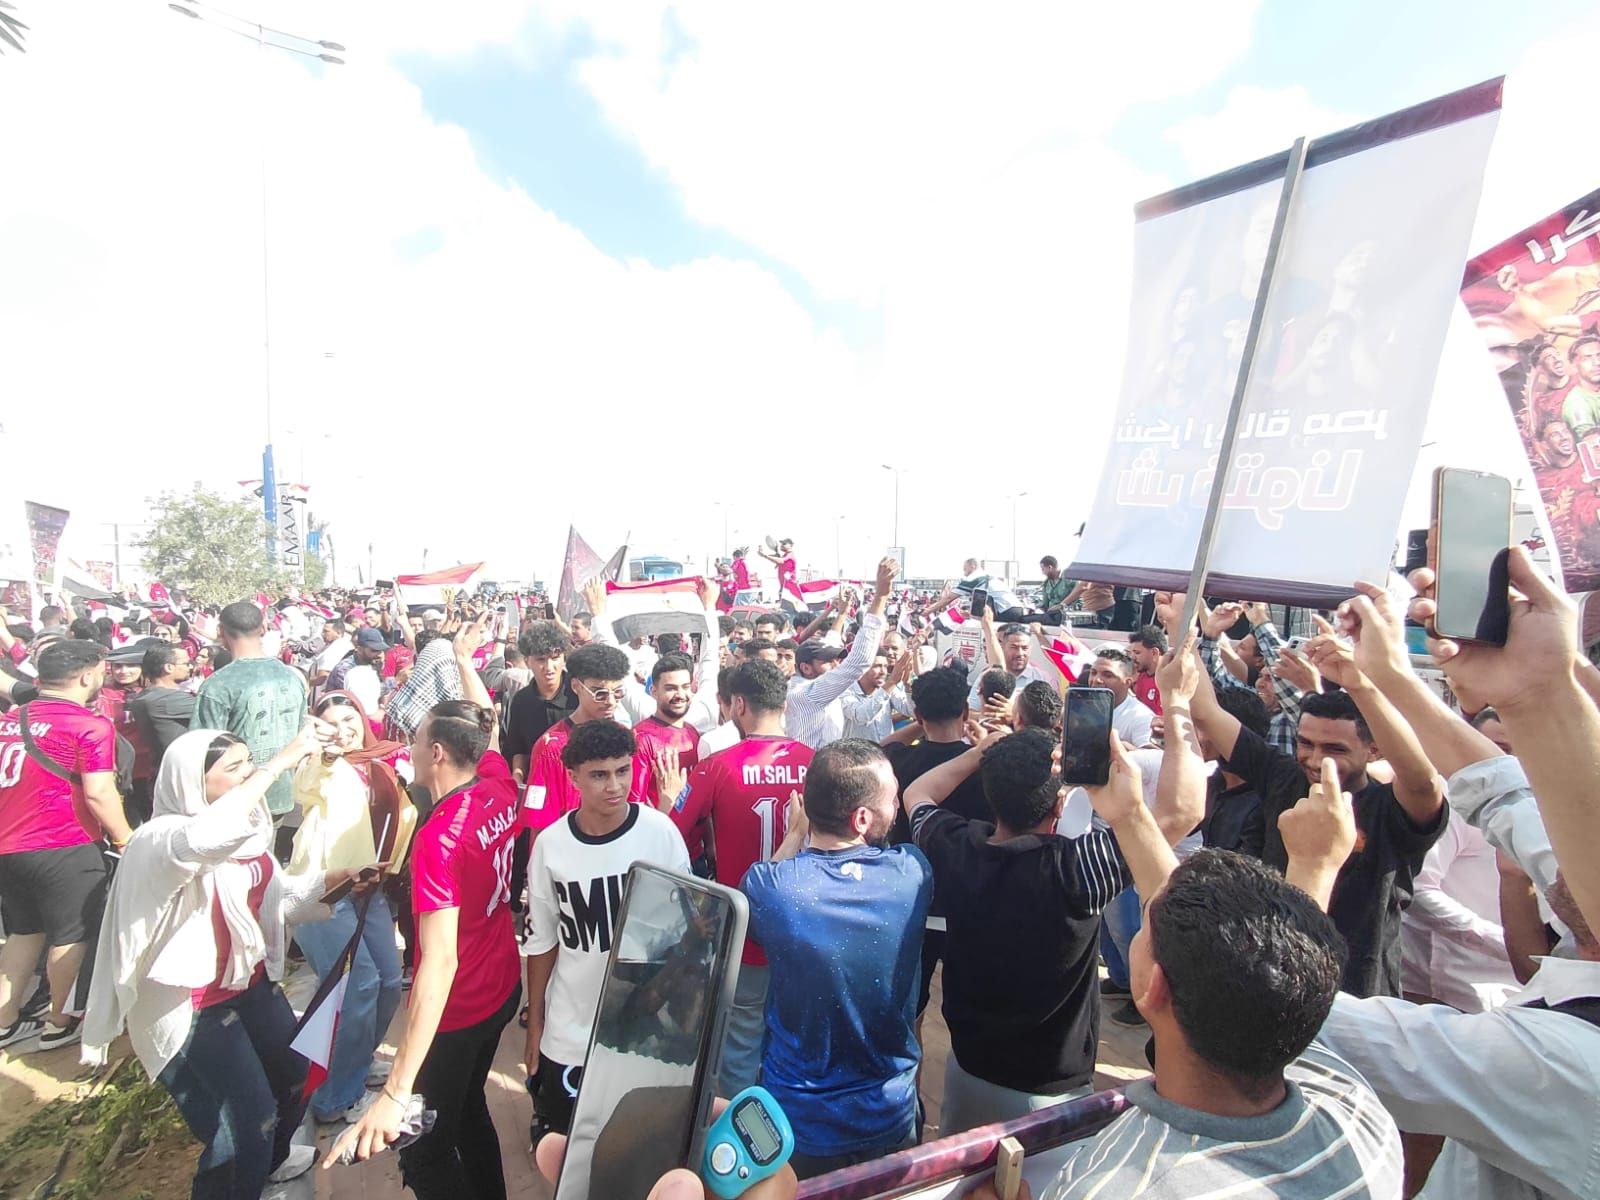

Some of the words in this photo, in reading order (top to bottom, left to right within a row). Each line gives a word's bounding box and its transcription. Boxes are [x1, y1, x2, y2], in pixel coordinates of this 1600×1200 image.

[1525, 209, 1600, 264] كرا
[280, 494, 300, 567] EMAAR
[0, 721, 52, 738] .SAAH
[0, 742, 27, 788] 0
[742, 764, 808, 785] M.SALA
[476, 800, 517, 851] M.SALA
[751, 797, 790, 862] 1
[487, 832, 515, 918] 10
[554, 873, 629, 953] SMI
[735, 1118, 747, 1137] COUNT
[750, 1143, 762, 1161] RESET
